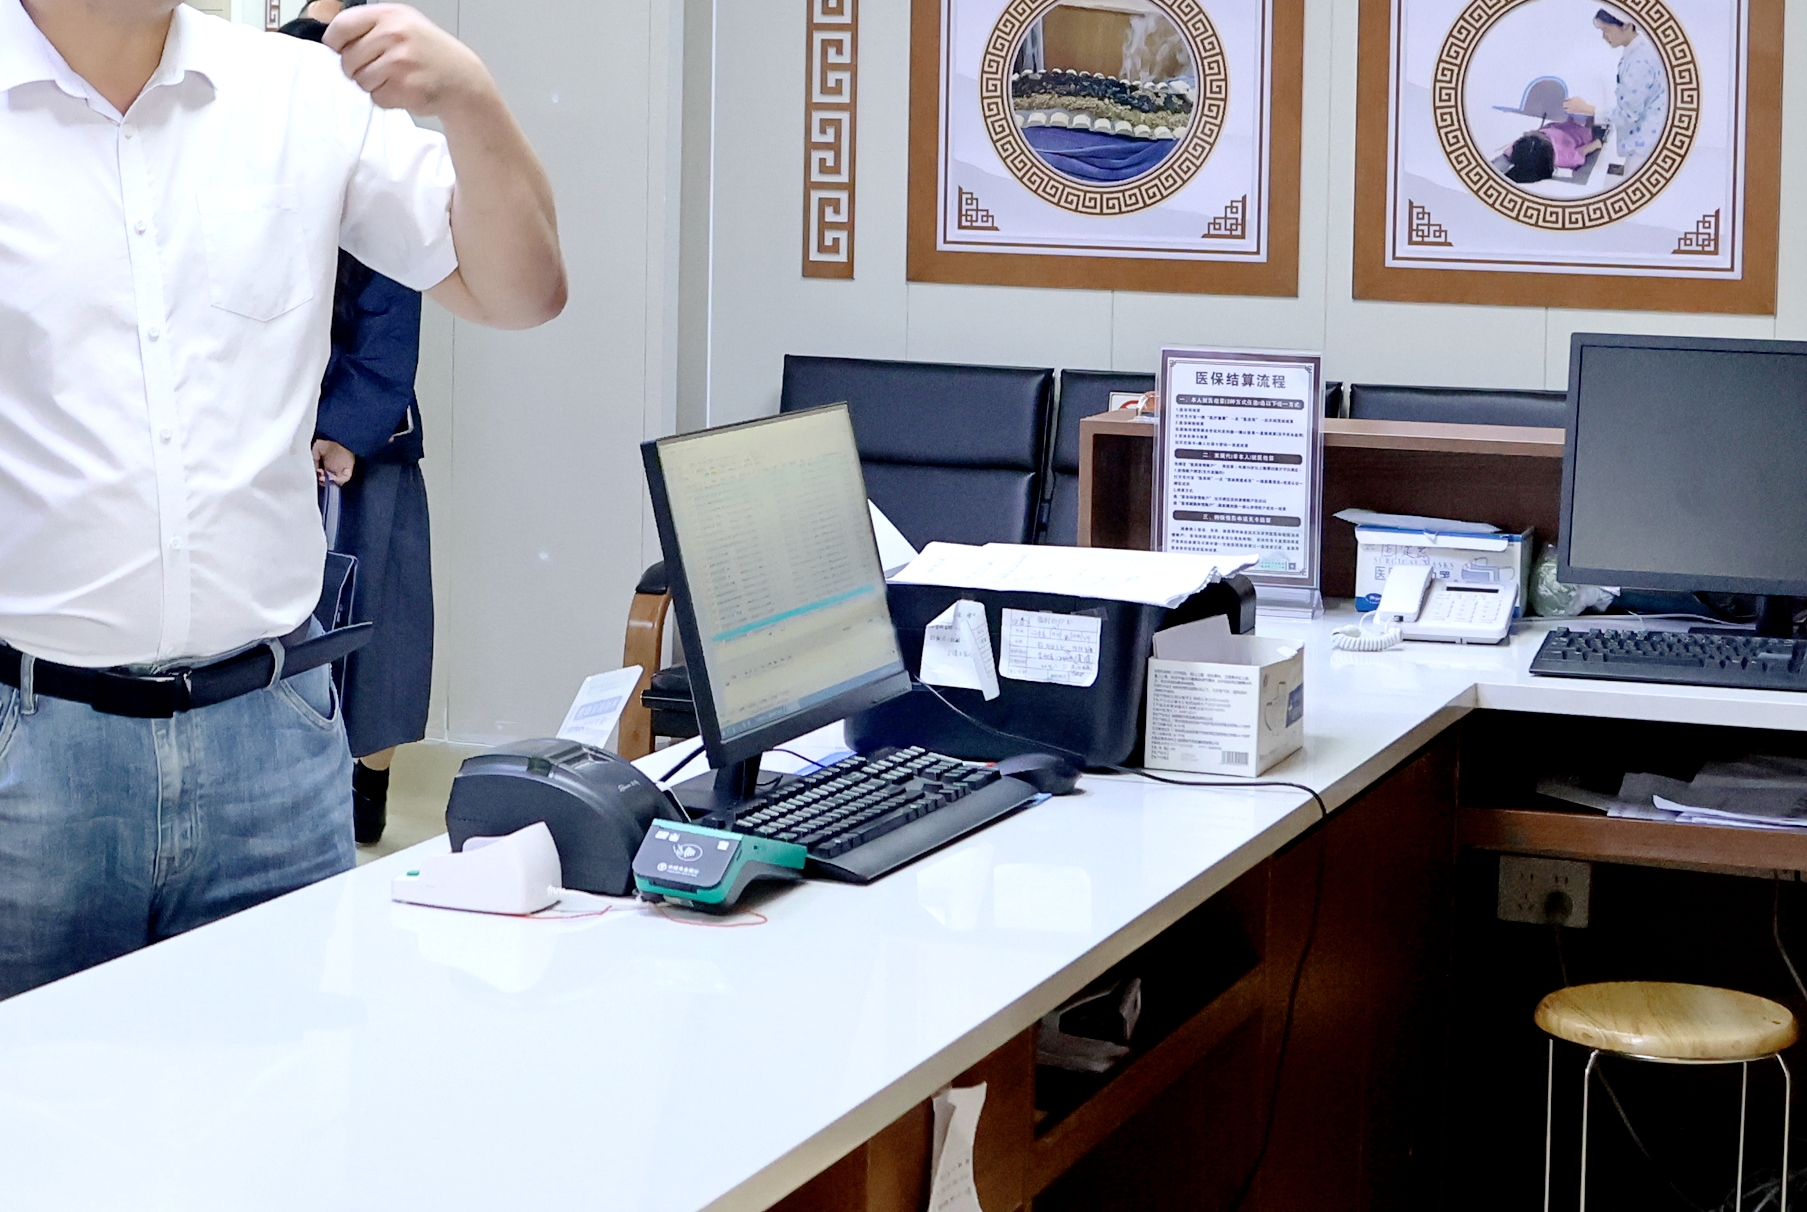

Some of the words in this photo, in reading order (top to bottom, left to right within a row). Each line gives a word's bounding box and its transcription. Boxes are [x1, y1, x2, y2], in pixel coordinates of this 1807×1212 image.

[1195, 371, 1287, 389] 医保结算流程
